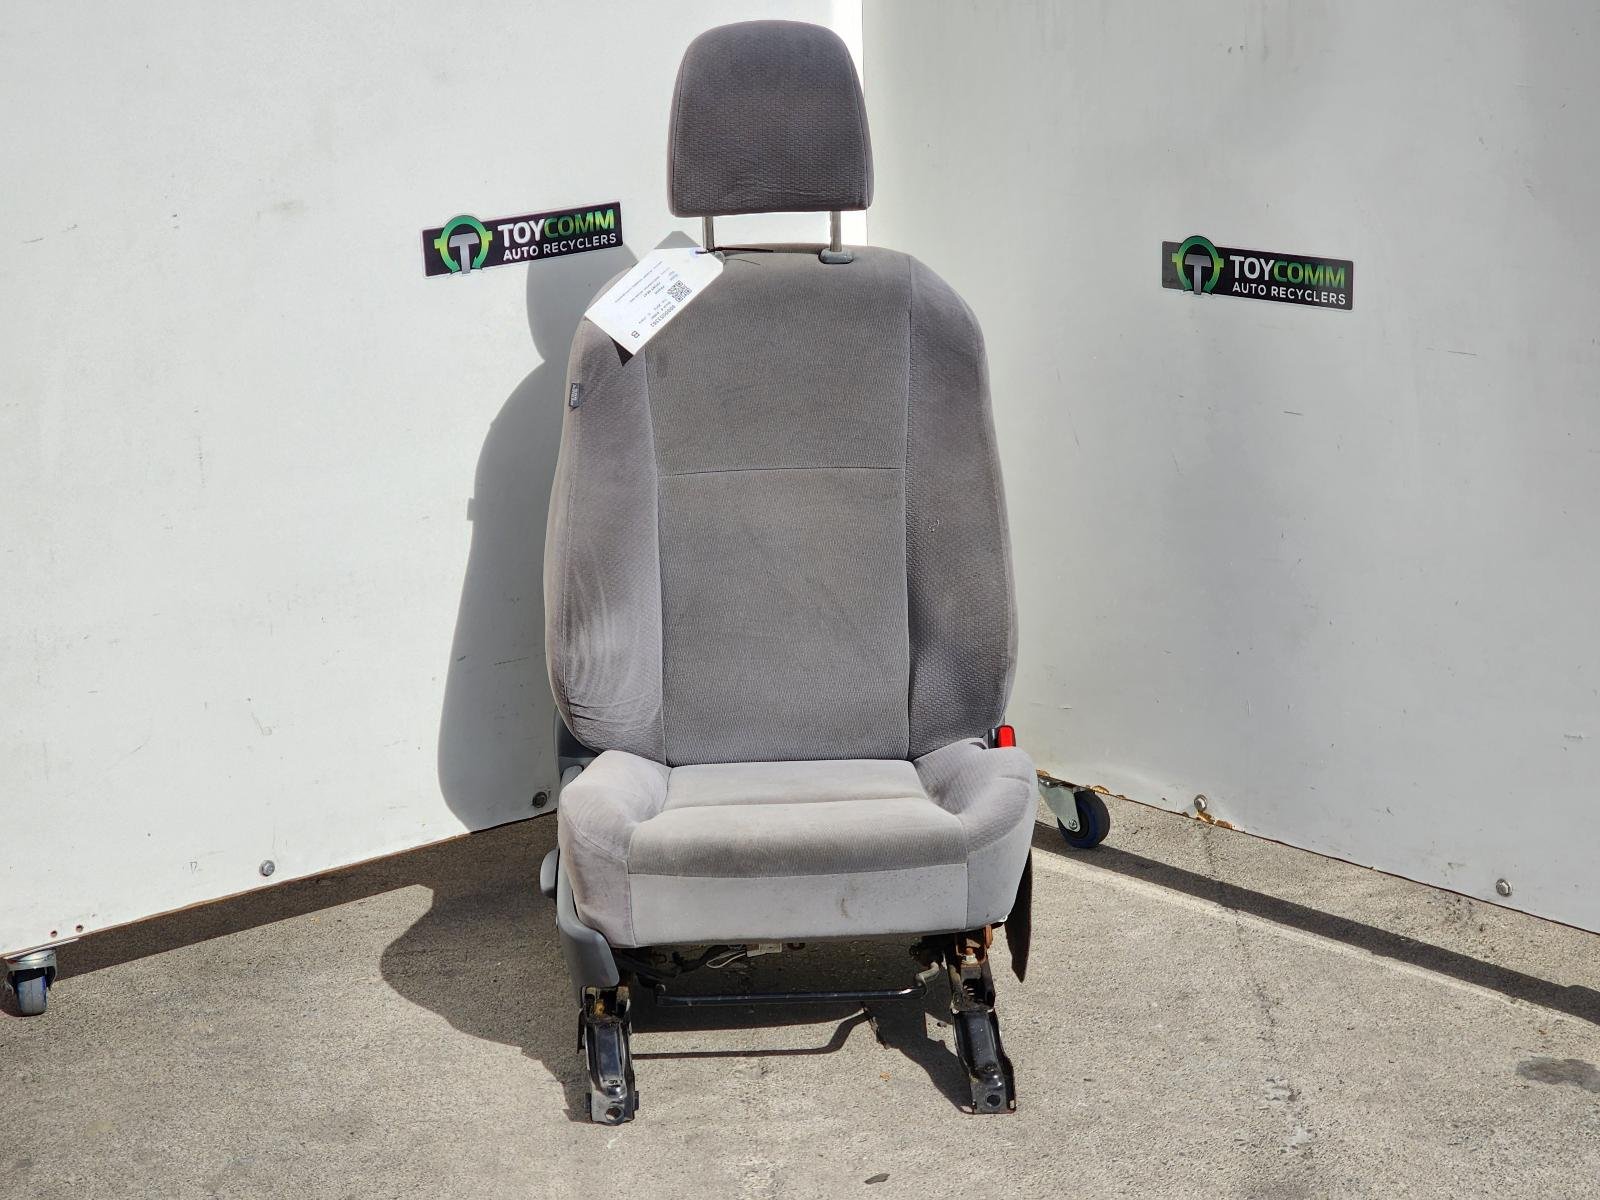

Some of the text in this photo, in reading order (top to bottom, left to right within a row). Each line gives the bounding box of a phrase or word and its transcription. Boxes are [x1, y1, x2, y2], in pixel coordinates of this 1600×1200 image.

[498, 208, 615, 248] TOYCOMM
[503, 233, 617, 261] AUTO RECYCLERS
[1230, 255, 1345, 289] TOYCOMM
[1232, 281, 1346, 305] AUTO RECYCLERS
